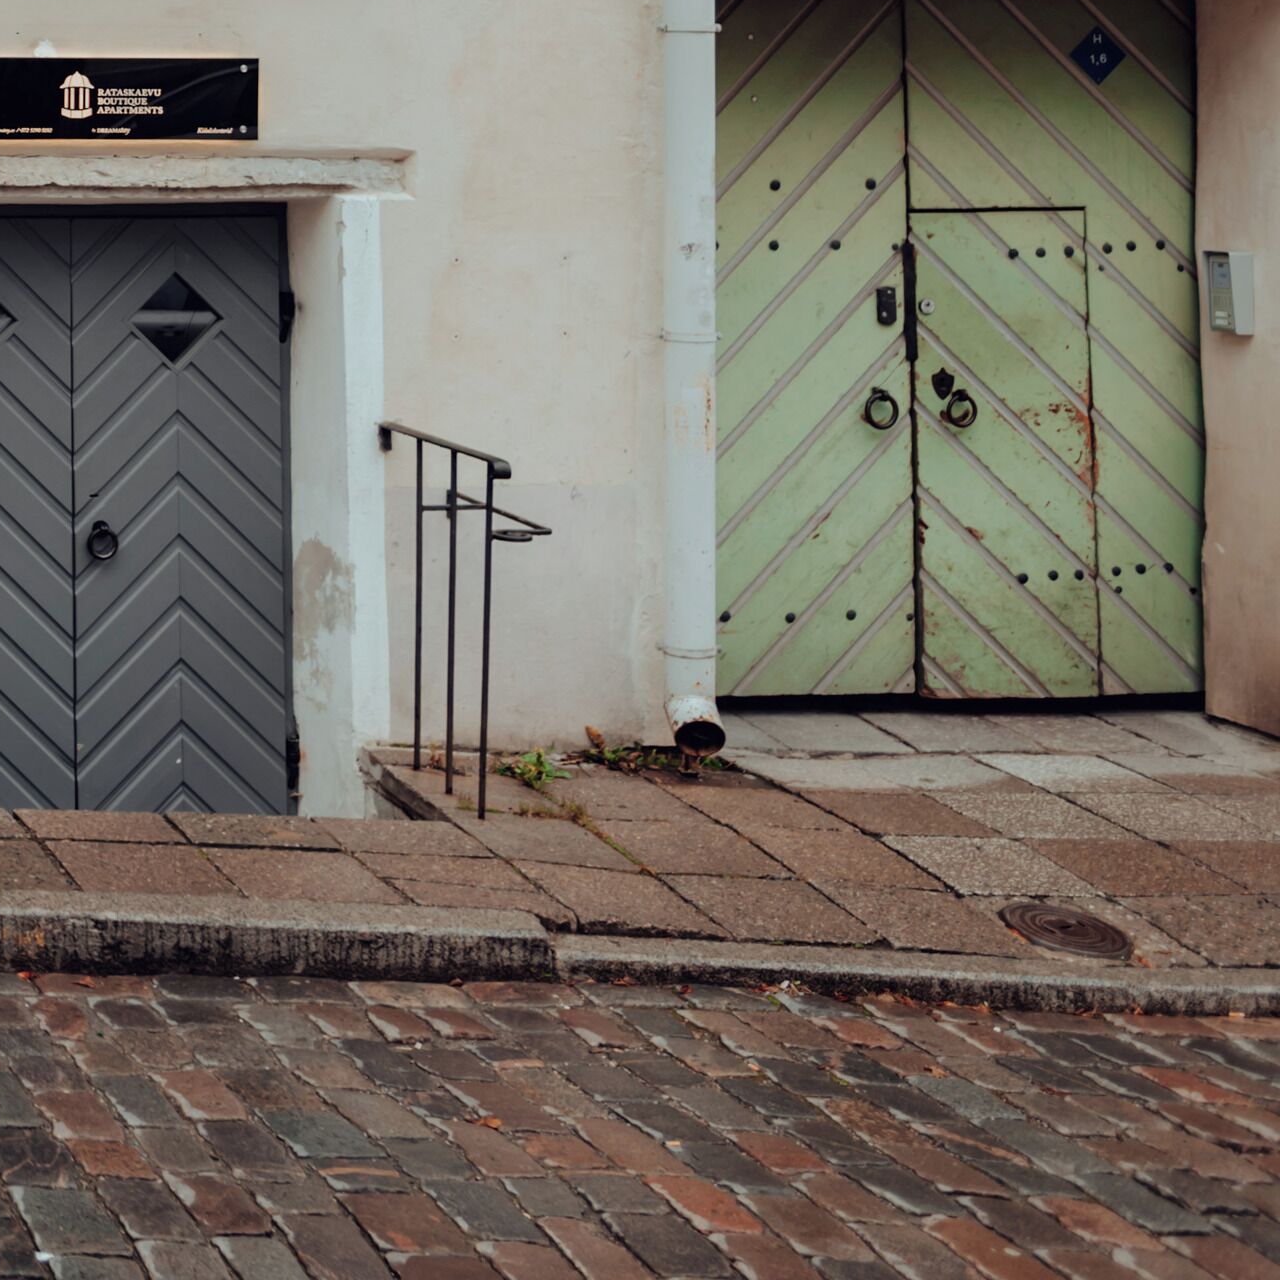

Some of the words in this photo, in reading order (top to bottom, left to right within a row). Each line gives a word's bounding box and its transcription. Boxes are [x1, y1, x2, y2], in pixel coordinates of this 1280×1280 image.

[1093, 33, 1102, 44] H
[1090, 53, 1107, 66] 1,6
[97, 88, 162, 97] RATASKAEVU
[97, 97, 148, 106] BOUTIQUE
[96, 106, 164, 115] APARTMENTS
